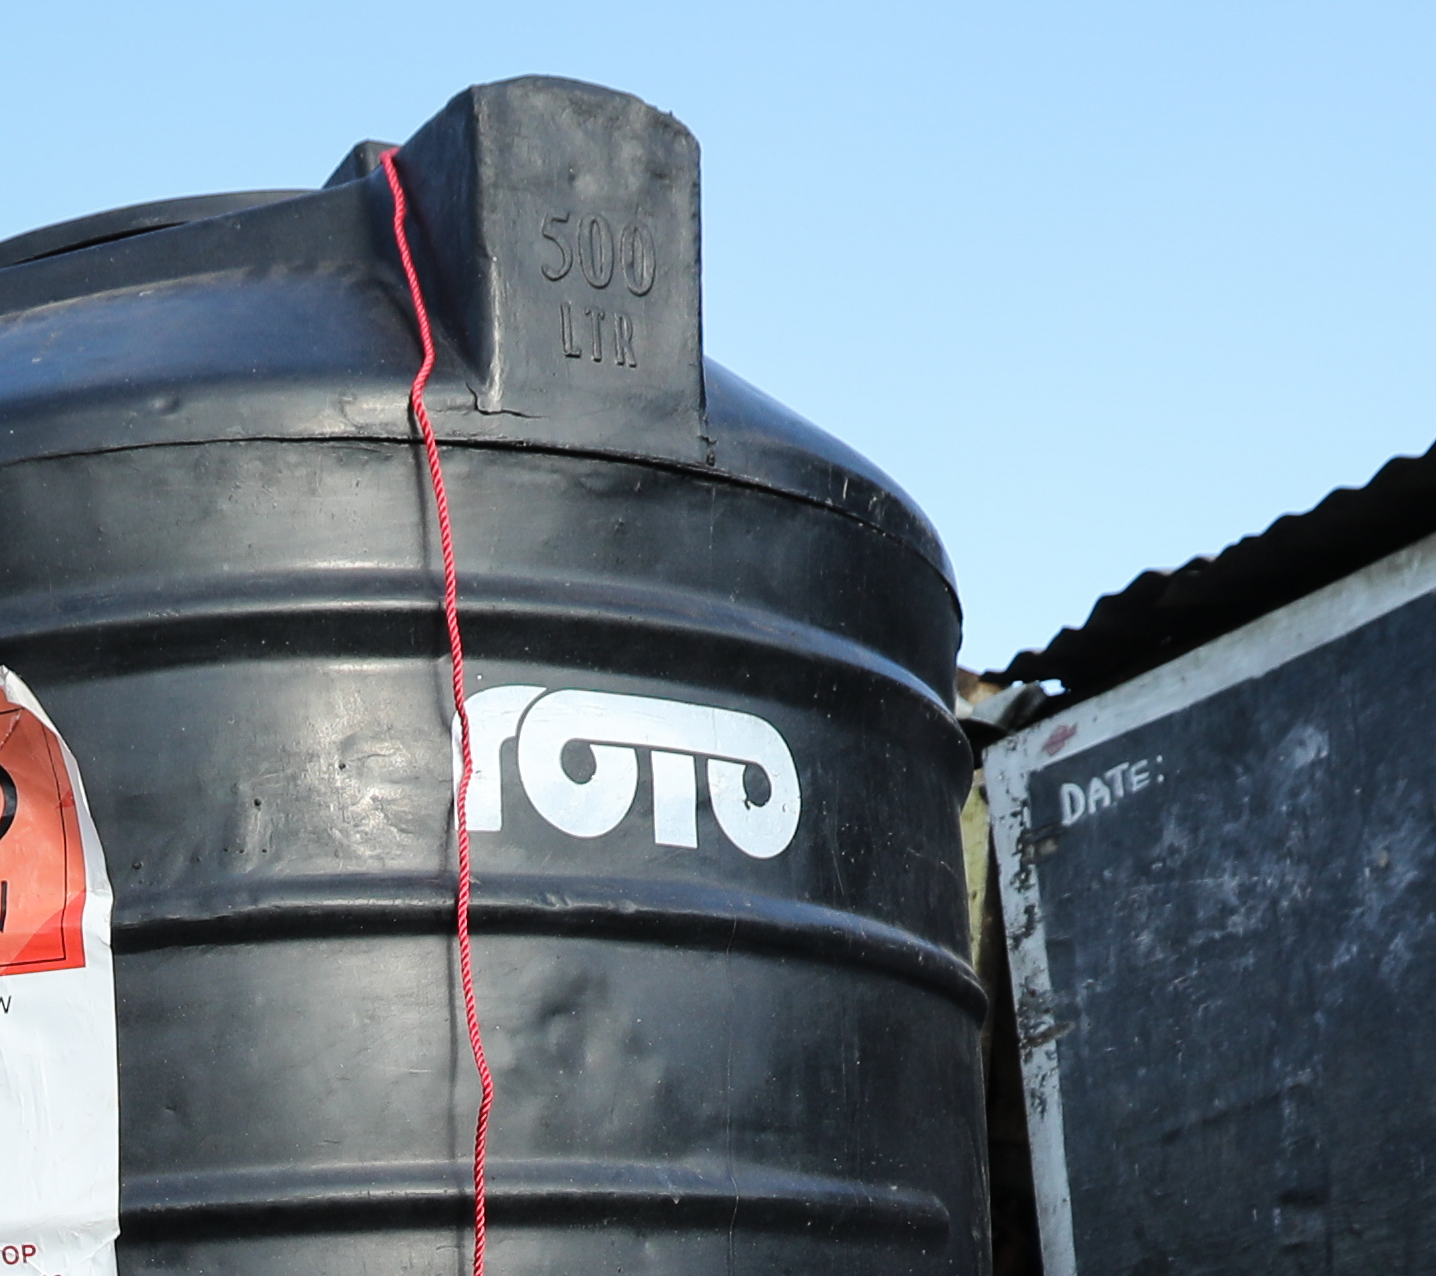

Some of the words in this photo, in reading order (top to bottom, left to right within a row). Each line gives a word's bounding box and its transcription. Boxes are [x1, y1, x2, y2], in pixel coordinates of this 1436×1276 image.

[540, 208, 657, 297] 500
[560, 301, 638, 369] LTR
[1059, 752, 1166, 827] DATE:
